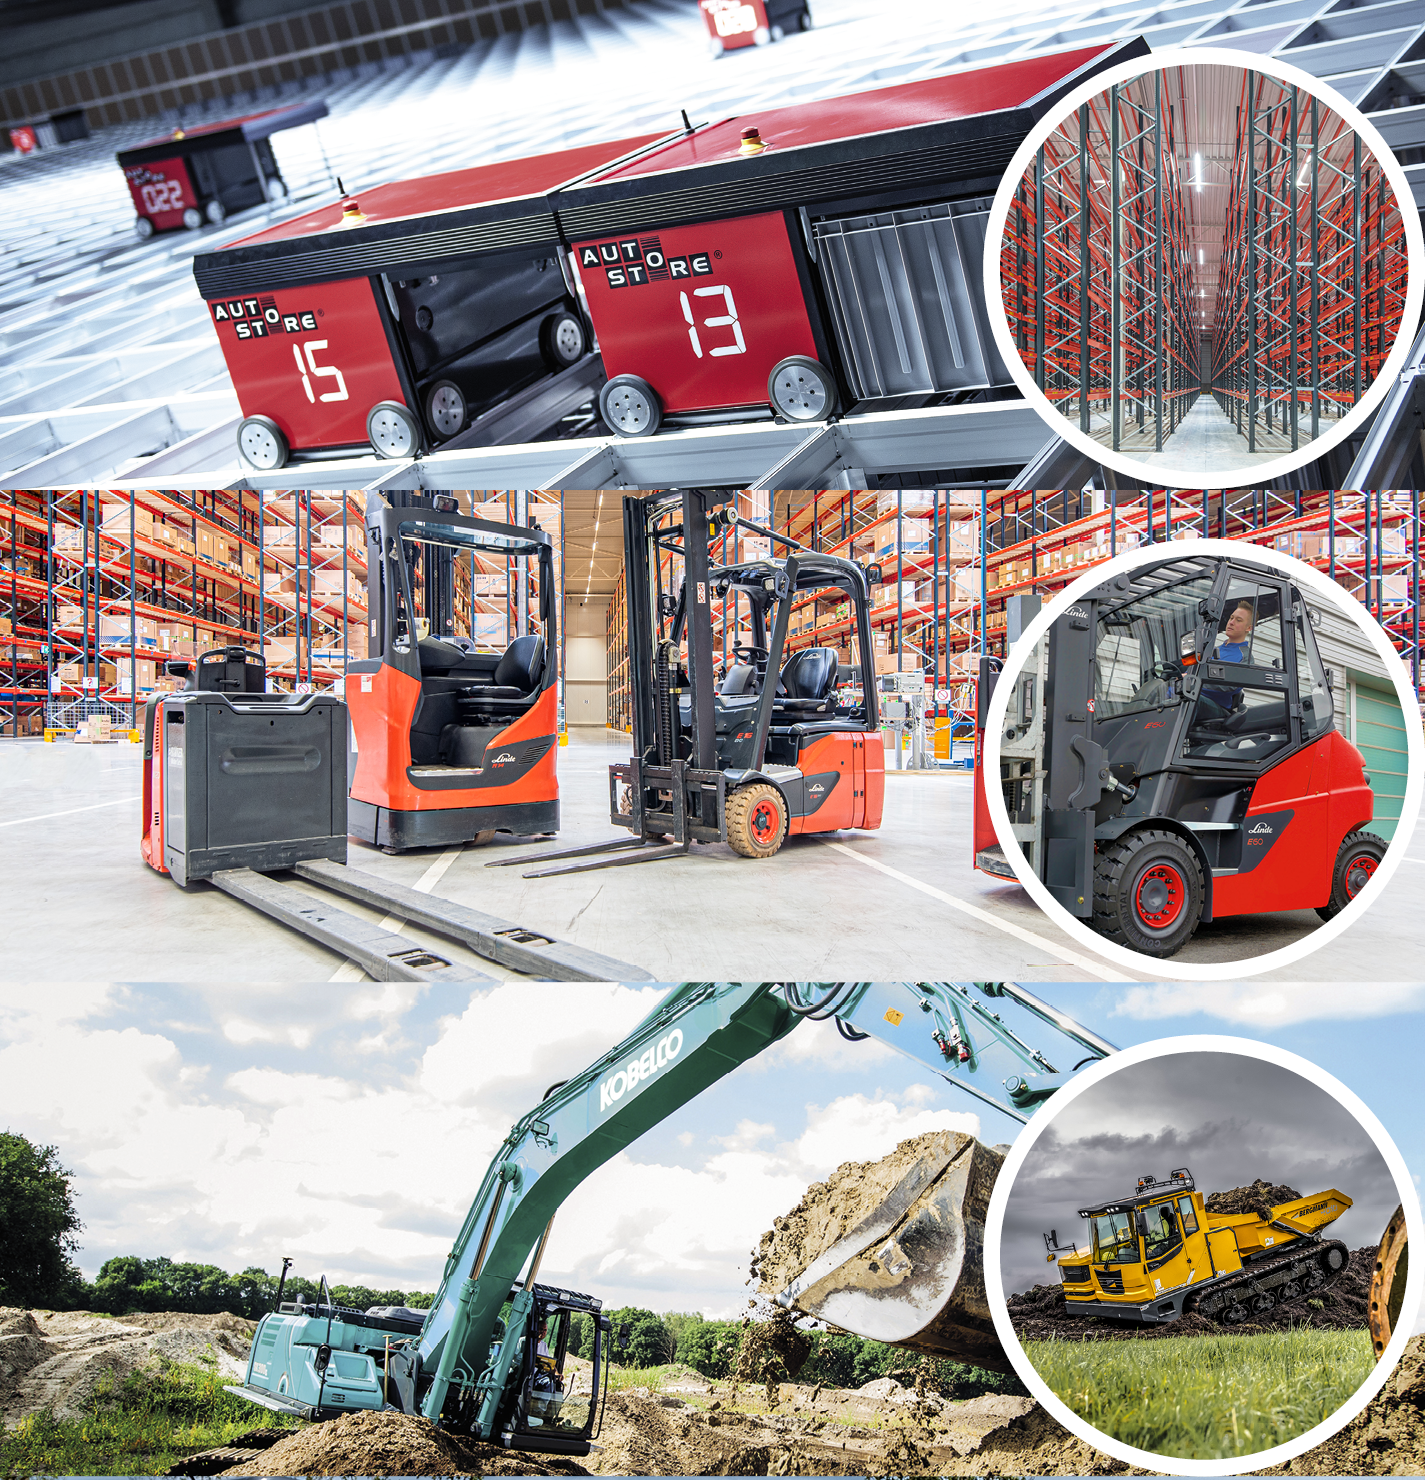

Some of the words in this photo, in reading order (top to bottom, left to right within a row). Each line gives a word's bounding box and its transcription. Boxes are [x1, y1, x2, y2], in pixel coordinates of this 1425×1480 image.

[141, 179, 184, 214] 022
[679, 284, 747, 359] 13
[292, 339, 349, 404] 15
[1063, 606, 1089, 619] Linde
[491, 752, 516, 764] Linde
[1248, 821, 1274, 834] Linde
[1247, 837, 1264, 846] E60
[600, 1028, 684, 1113] KOBELCO
